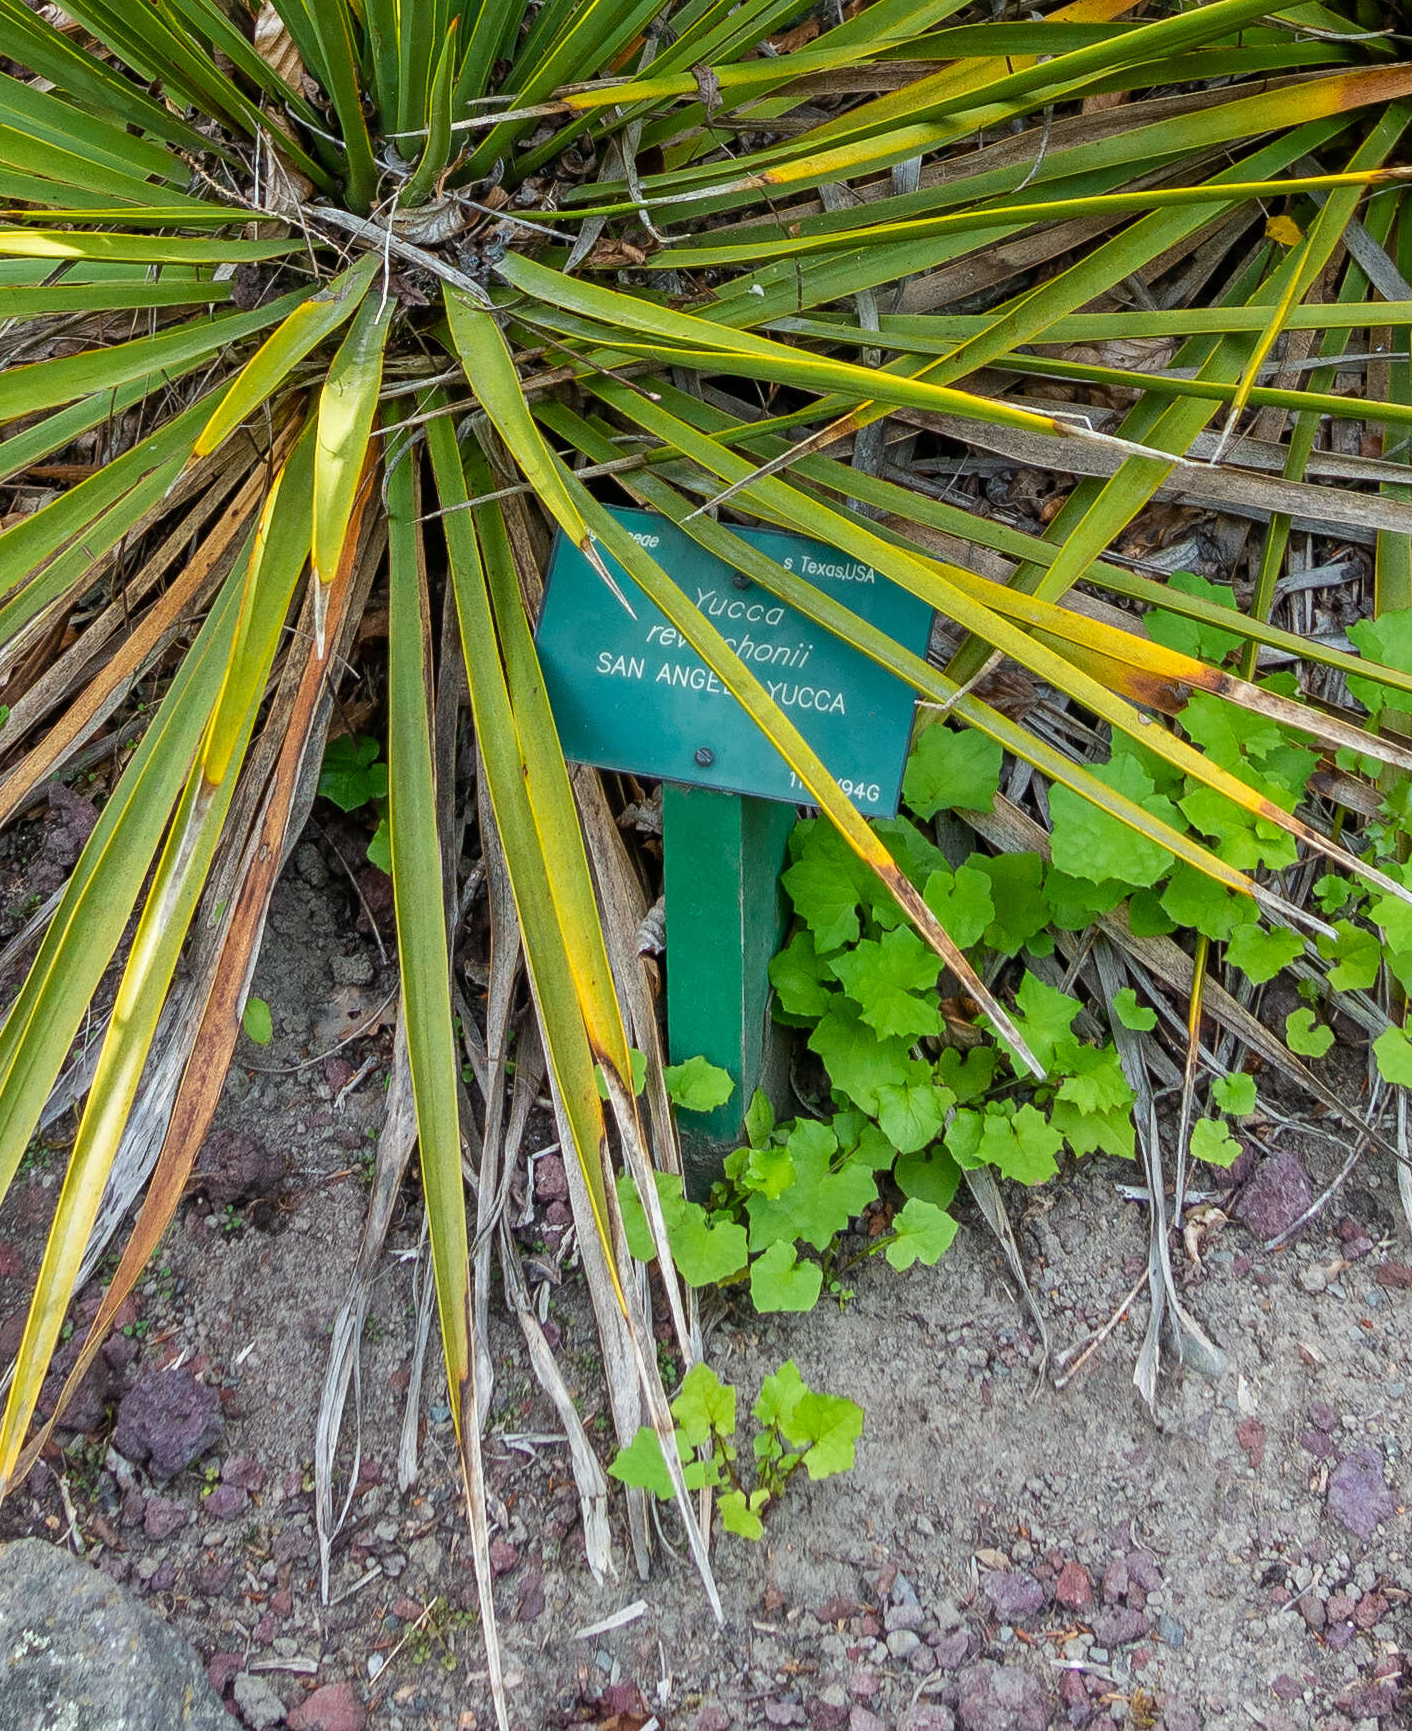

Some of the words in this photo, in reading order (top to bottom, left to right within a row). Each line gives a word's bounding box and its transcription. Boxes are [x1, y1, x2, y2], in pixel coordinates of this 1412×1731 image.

[800, 555, 876, 585] Texas,USA
[695, 586, 785, 626] Yucca
[645, 624, 814, 669] revhonii
[597, 651, 645, 680] SAN
[655, 662, 733, 696] ANGE
[766, 679, 846, 715] YUCCA
